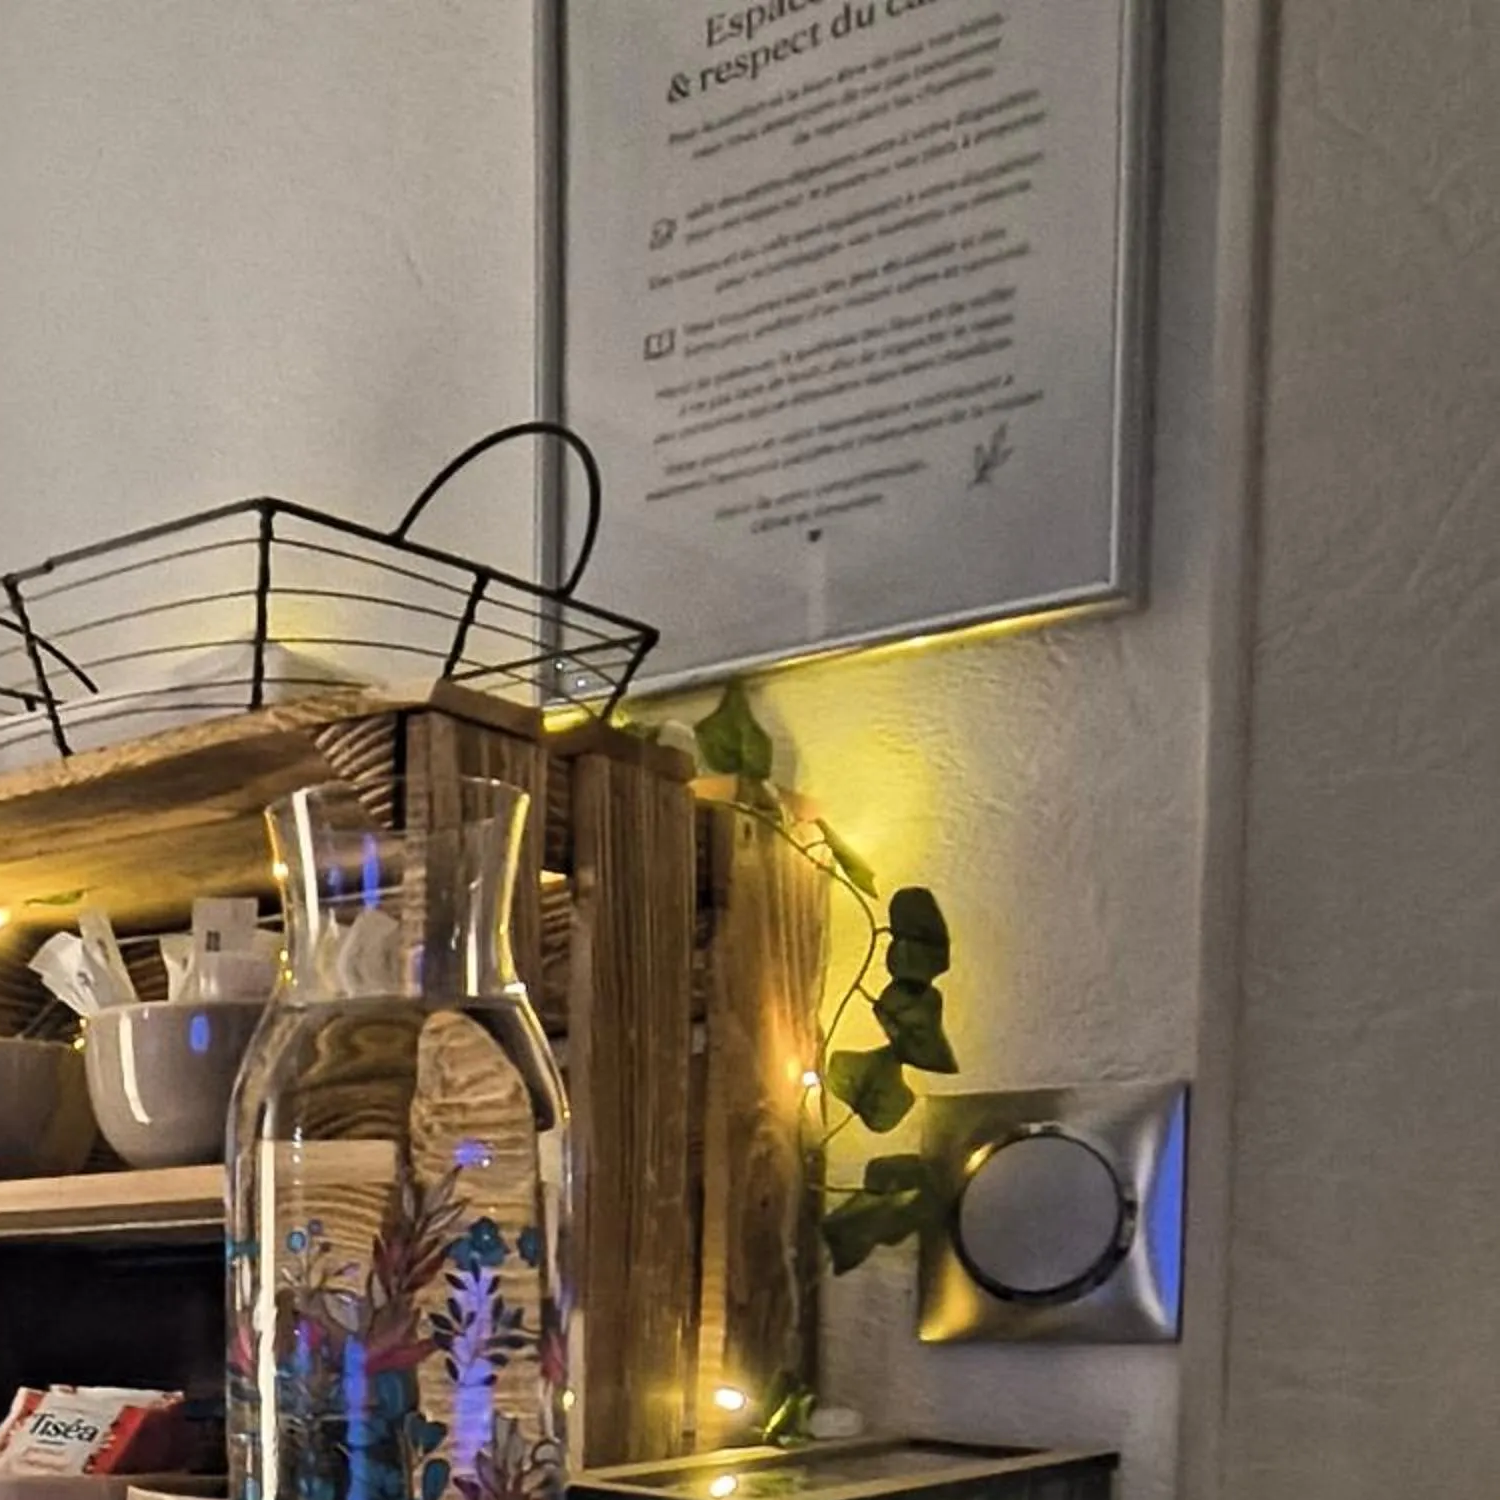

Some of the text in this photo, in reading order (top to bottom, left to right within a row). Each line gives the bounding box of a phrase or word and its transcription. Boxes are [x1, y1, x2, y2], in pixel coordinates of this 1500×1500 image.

[667, 72, 691, 104] &
[699, 21, 821, 91] respect
[831, 1, 875, 39] du
[707, 0, 821, 47] Espac
